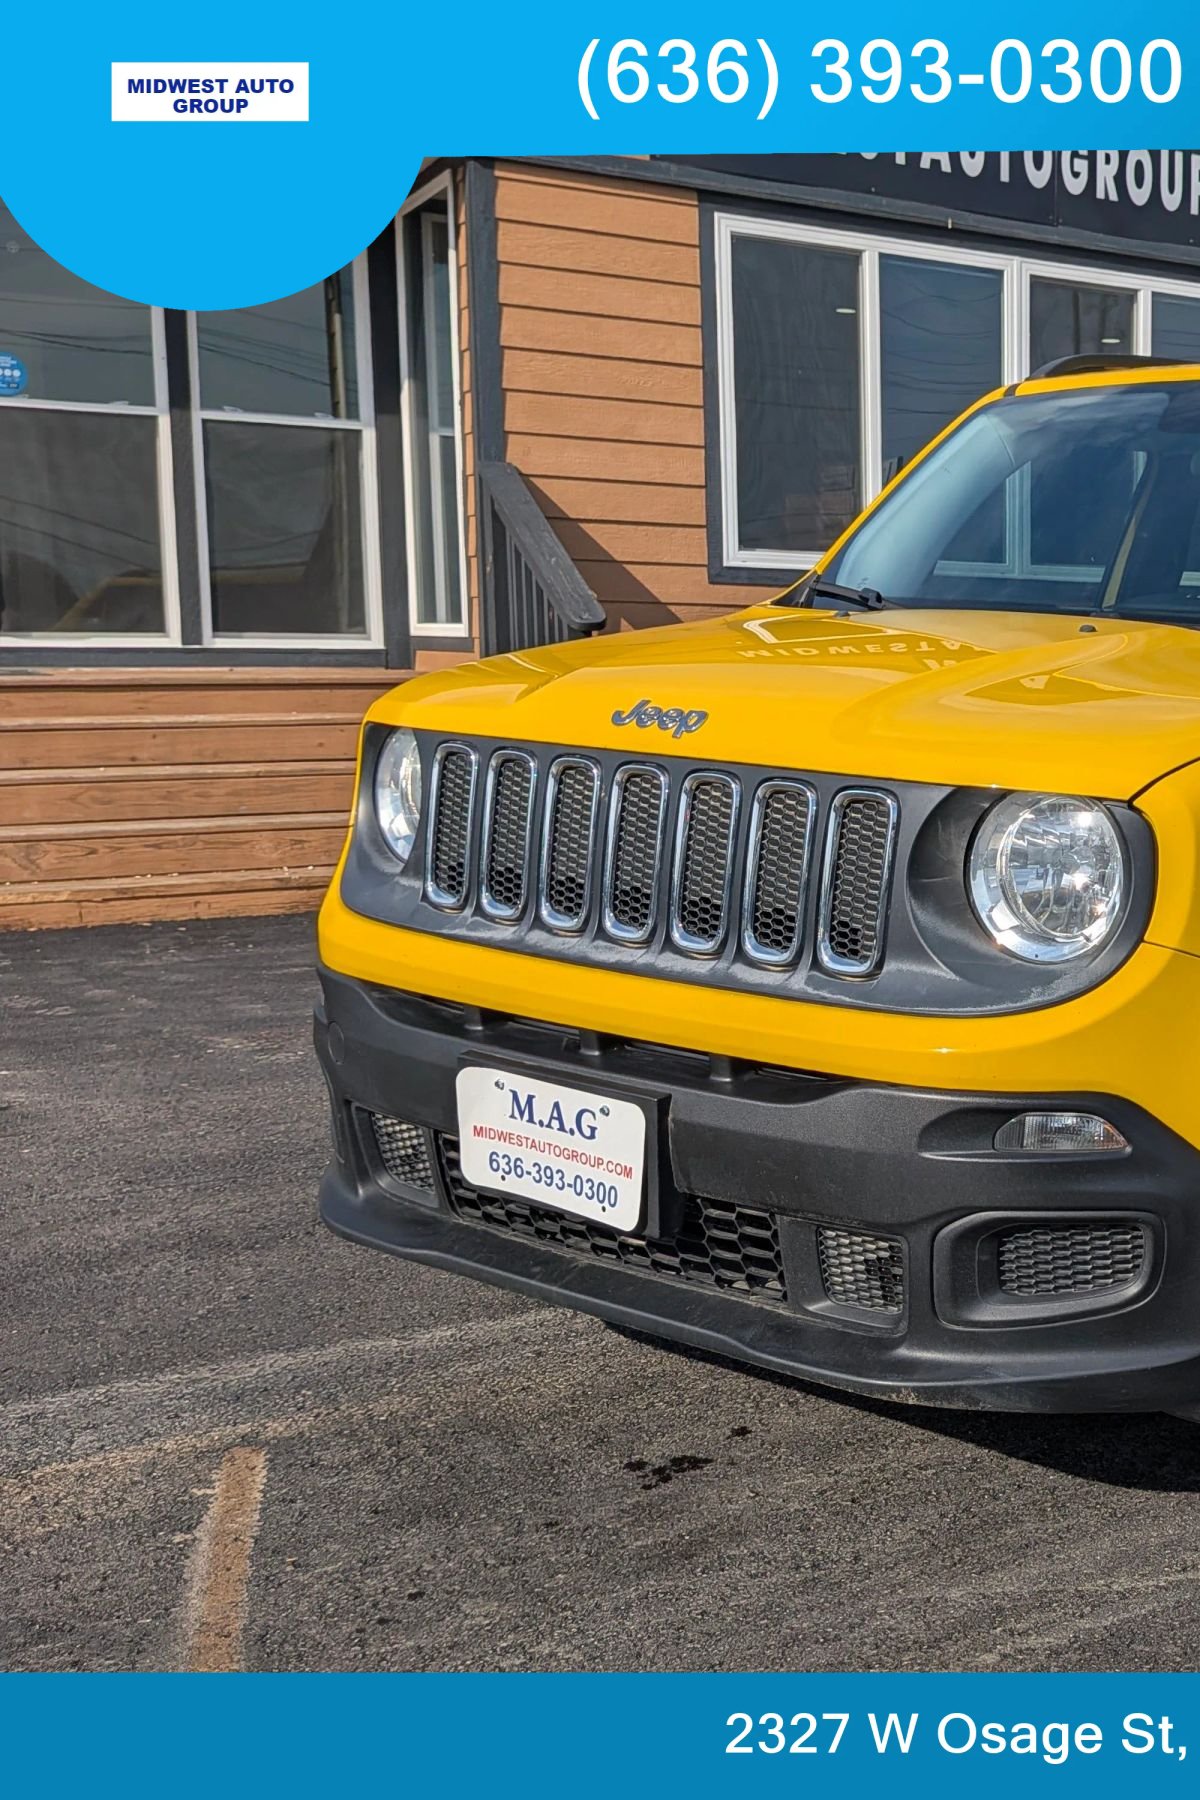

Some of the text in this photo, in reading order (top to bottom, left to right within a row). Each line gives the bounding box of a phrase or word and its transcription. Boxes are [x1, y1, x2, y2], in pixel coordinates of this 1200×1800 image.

[611, 699, 709, 740] Jeep
[508, 1088, 599, 1141] M.A.G
[472, 1124, 634, 1180] MIDWESTAUTOGROUP.COM
[488, 1150, 619, 1209] 636-393-0300
